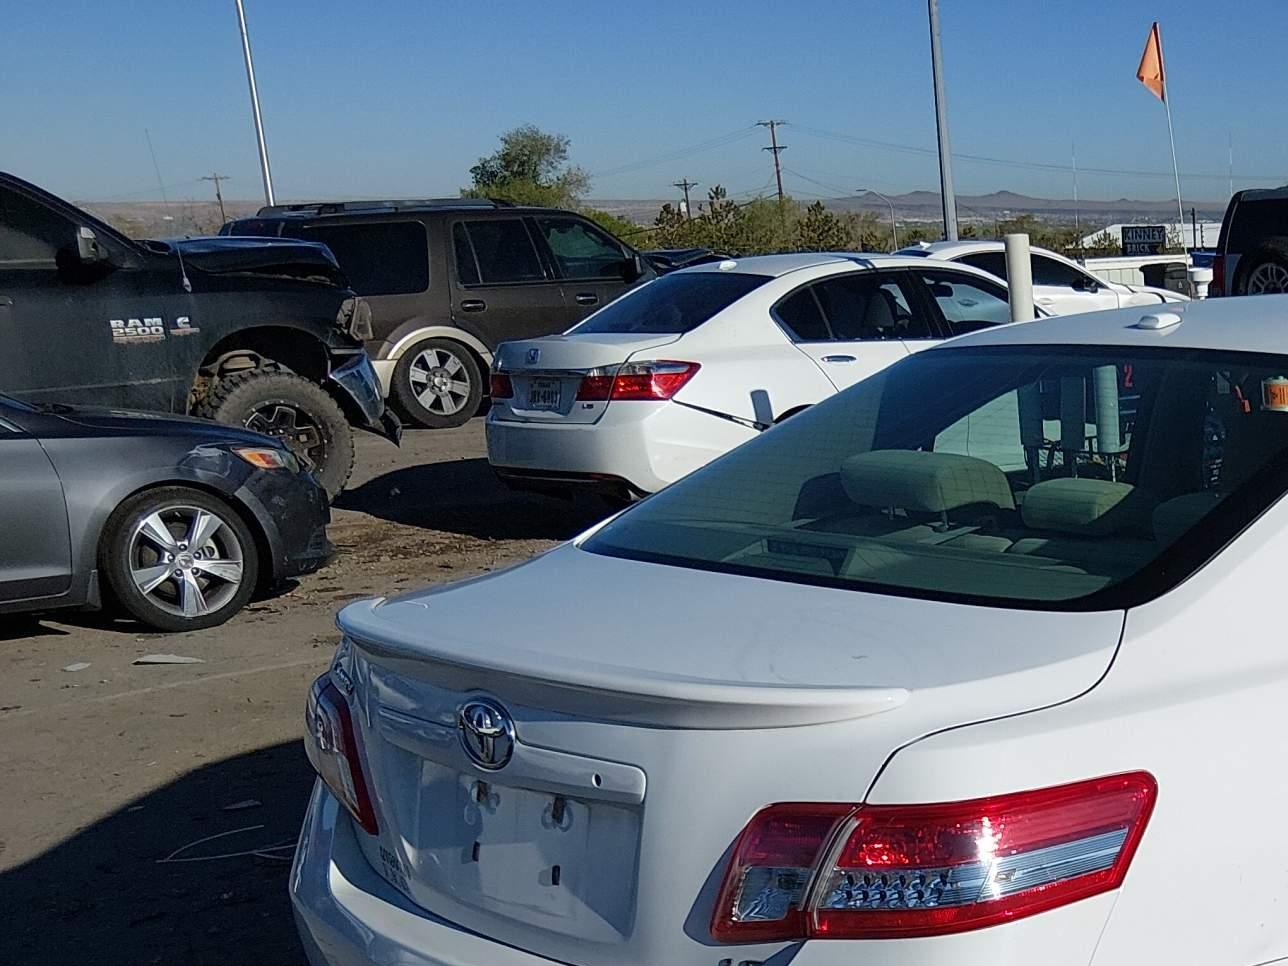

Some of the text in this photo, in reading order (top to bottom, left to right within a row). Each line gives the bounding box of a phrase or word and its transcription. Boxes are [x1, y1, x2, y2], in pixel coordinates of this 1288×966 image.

[1123, 229, 1163, 241] KINNEY
[110, 317, 163, 328] RAM
[112, 327, 164, 336] 2500
